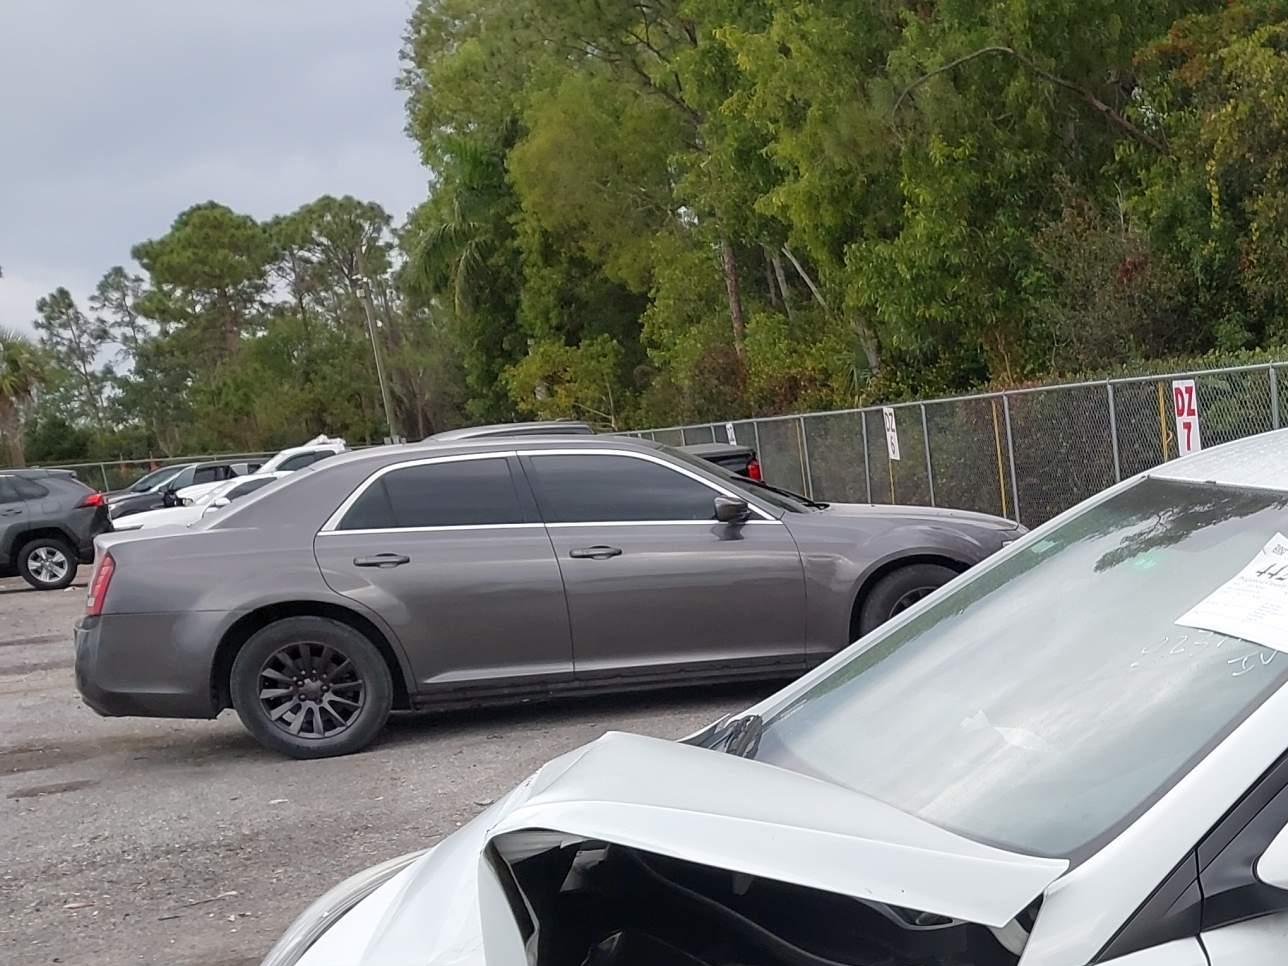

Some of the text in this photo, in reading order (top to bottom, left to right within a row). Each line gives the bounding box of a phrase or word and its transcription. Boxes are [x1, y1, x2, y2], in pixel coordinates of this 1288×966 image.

[1174, 385, 1196, 417] DZ
[884, 412, 896, 433] DZ
[1182, 421, 1193, 451] 7
